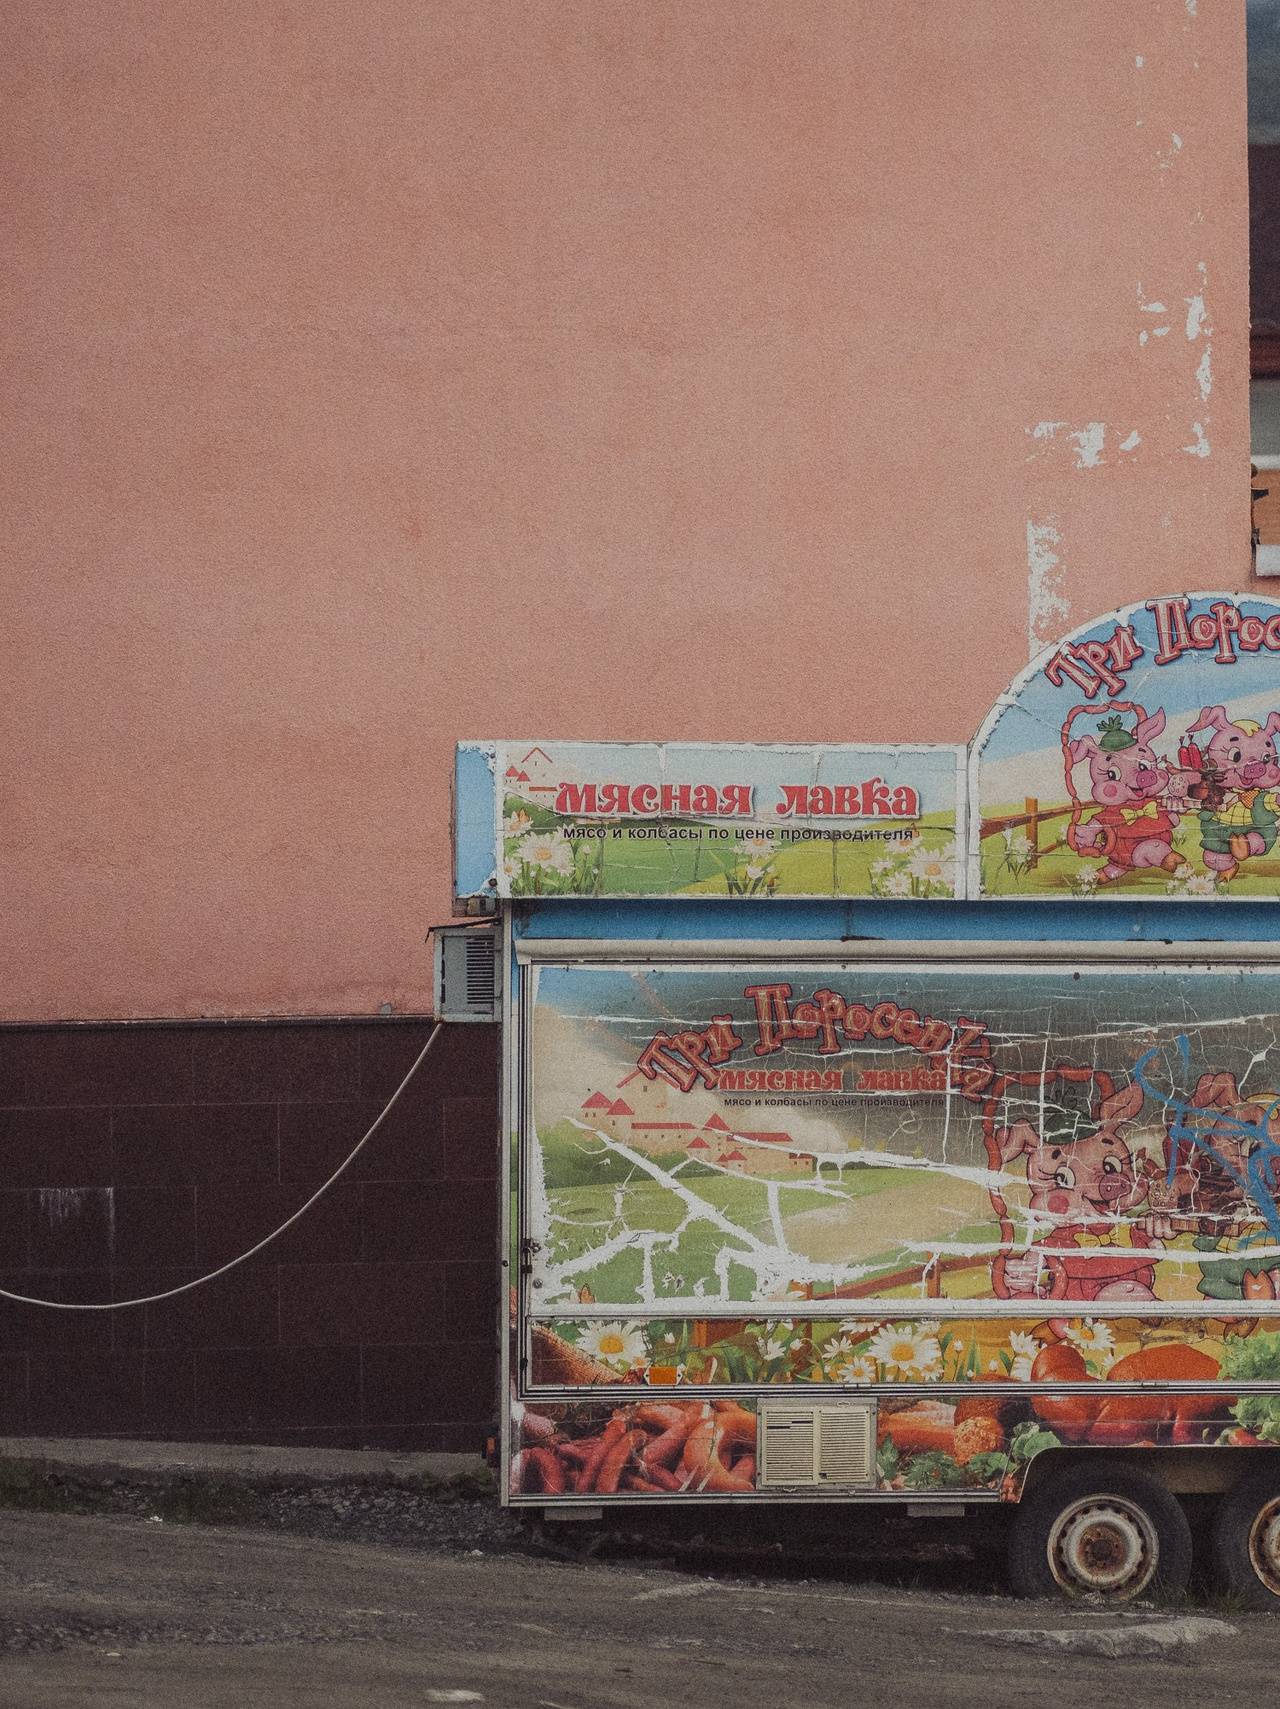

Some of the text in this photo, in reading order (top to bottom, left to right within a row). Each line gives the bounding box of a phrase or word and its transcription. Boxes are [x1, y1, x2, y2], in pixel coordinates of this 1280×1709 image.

[1044, 625, 1145, 699] Три
[555, 776, 918, 816] мясная лавка
[563, 825, 914, 843] мясо и колбасы по цене производителя
[637, 1013, 744, 1093] Три
[718, 1065, 948, 1091] мясная лавка
[724, 1096, 944, 1109] мясо и колбасы по цене производителя
